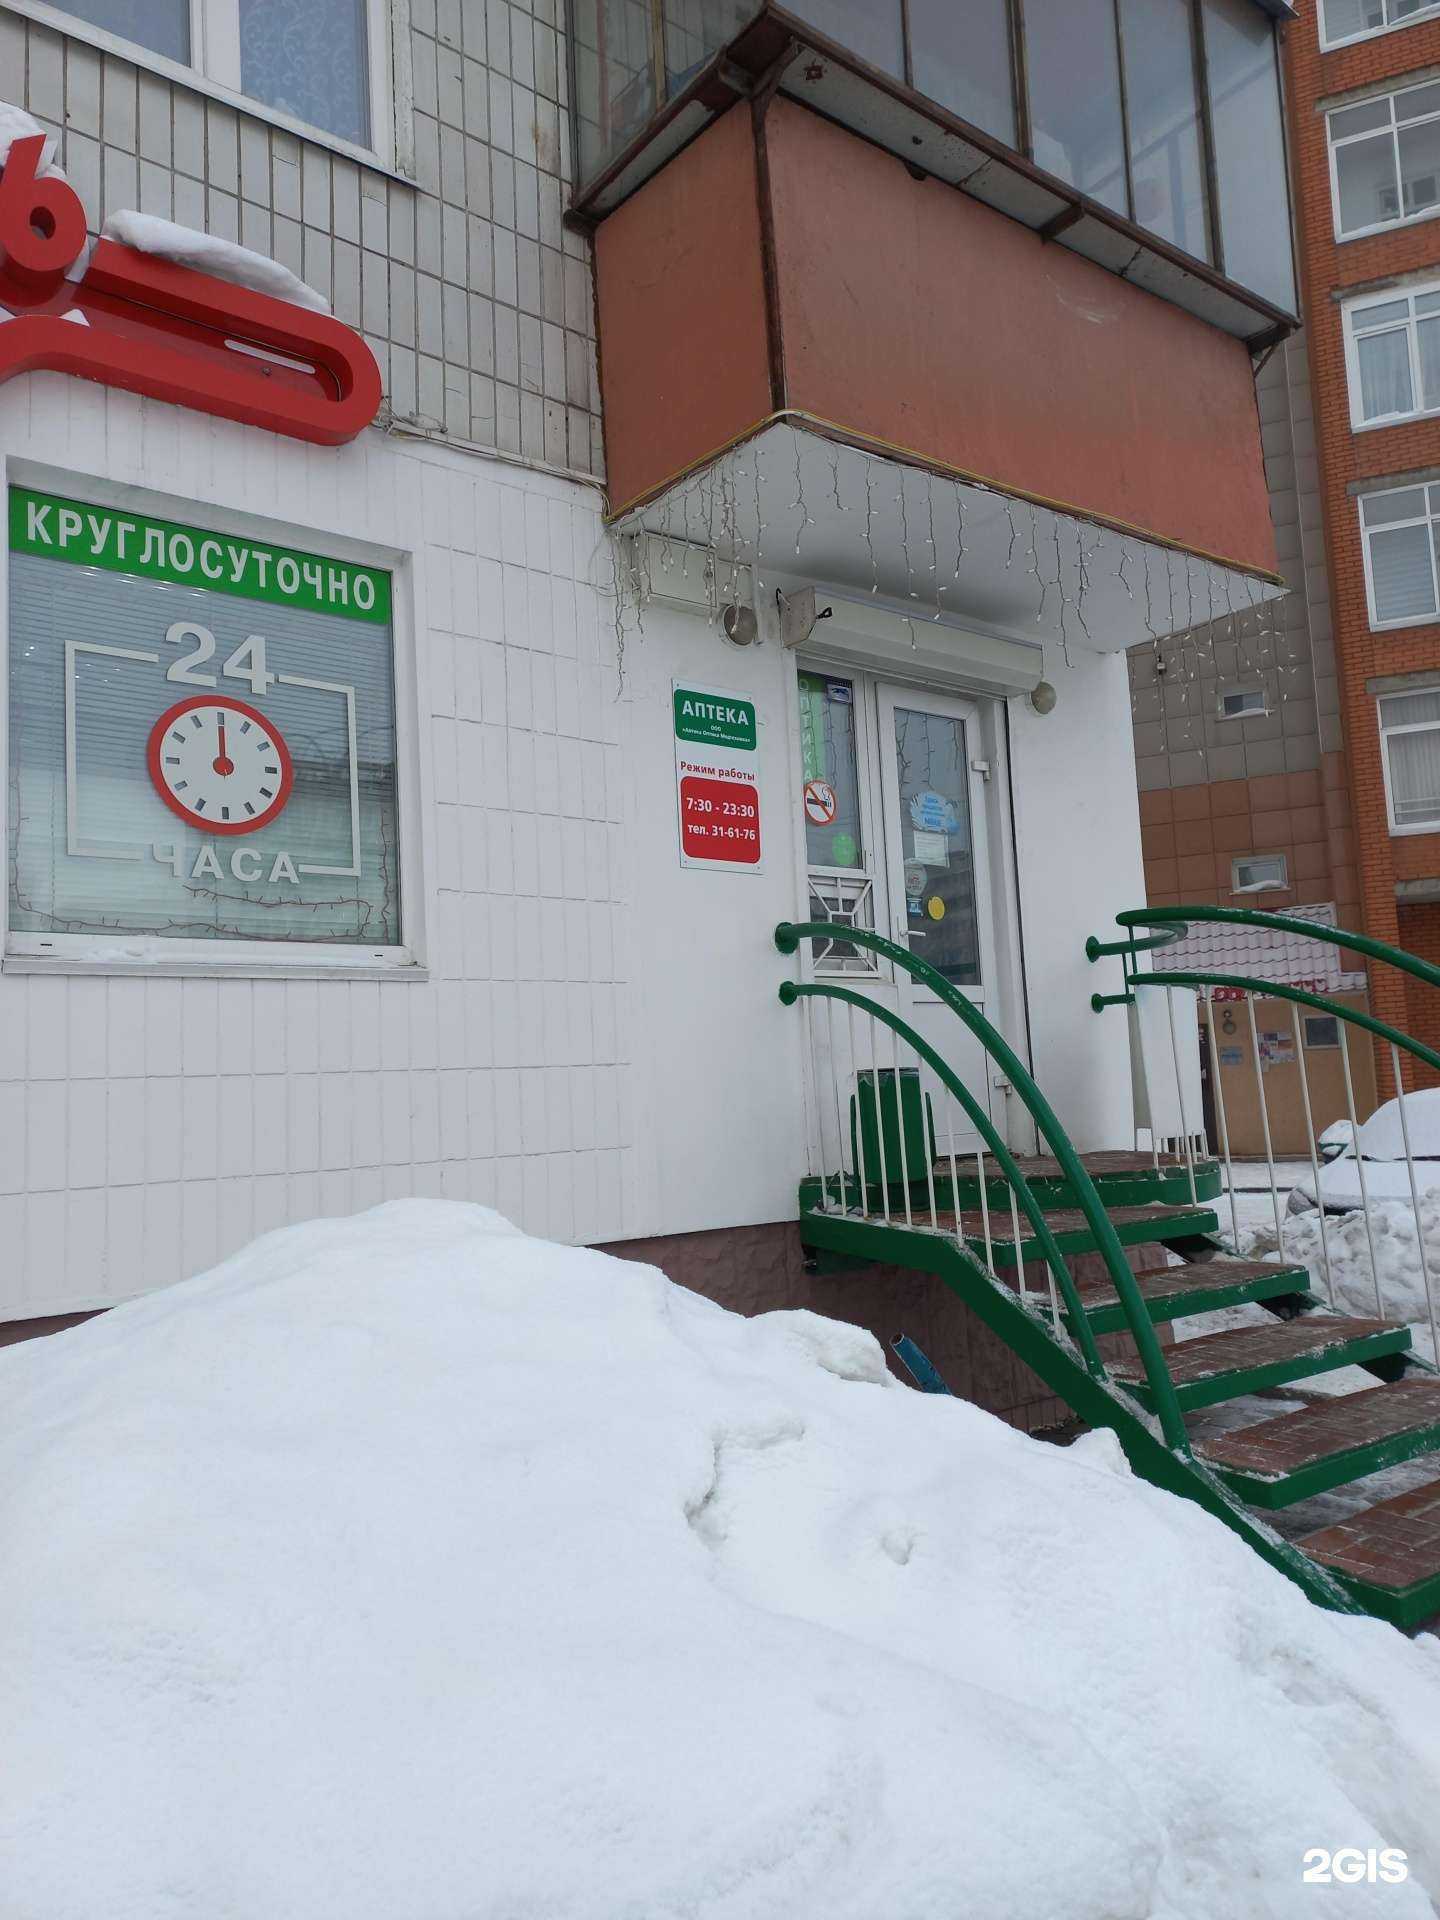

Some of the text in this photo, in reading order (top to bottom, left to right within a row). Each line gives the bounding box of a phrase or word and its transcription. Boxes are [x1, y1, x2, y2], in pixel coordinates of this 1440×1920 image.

[26, 501, 376, 610] КРУГЛОСУТОЧНО
[164, 622, 275, 695] 24
[682, 700, 749, 726] АПТЕКА
[680, 761, 755, 781] Режим работы
[686, 797, 712, 812] 7:30
[722, 802, 755, 818] 23:30
[687, 824, 756, 840] тел. 31-61-76
[151, 843, 301, 884] ЧАСА
